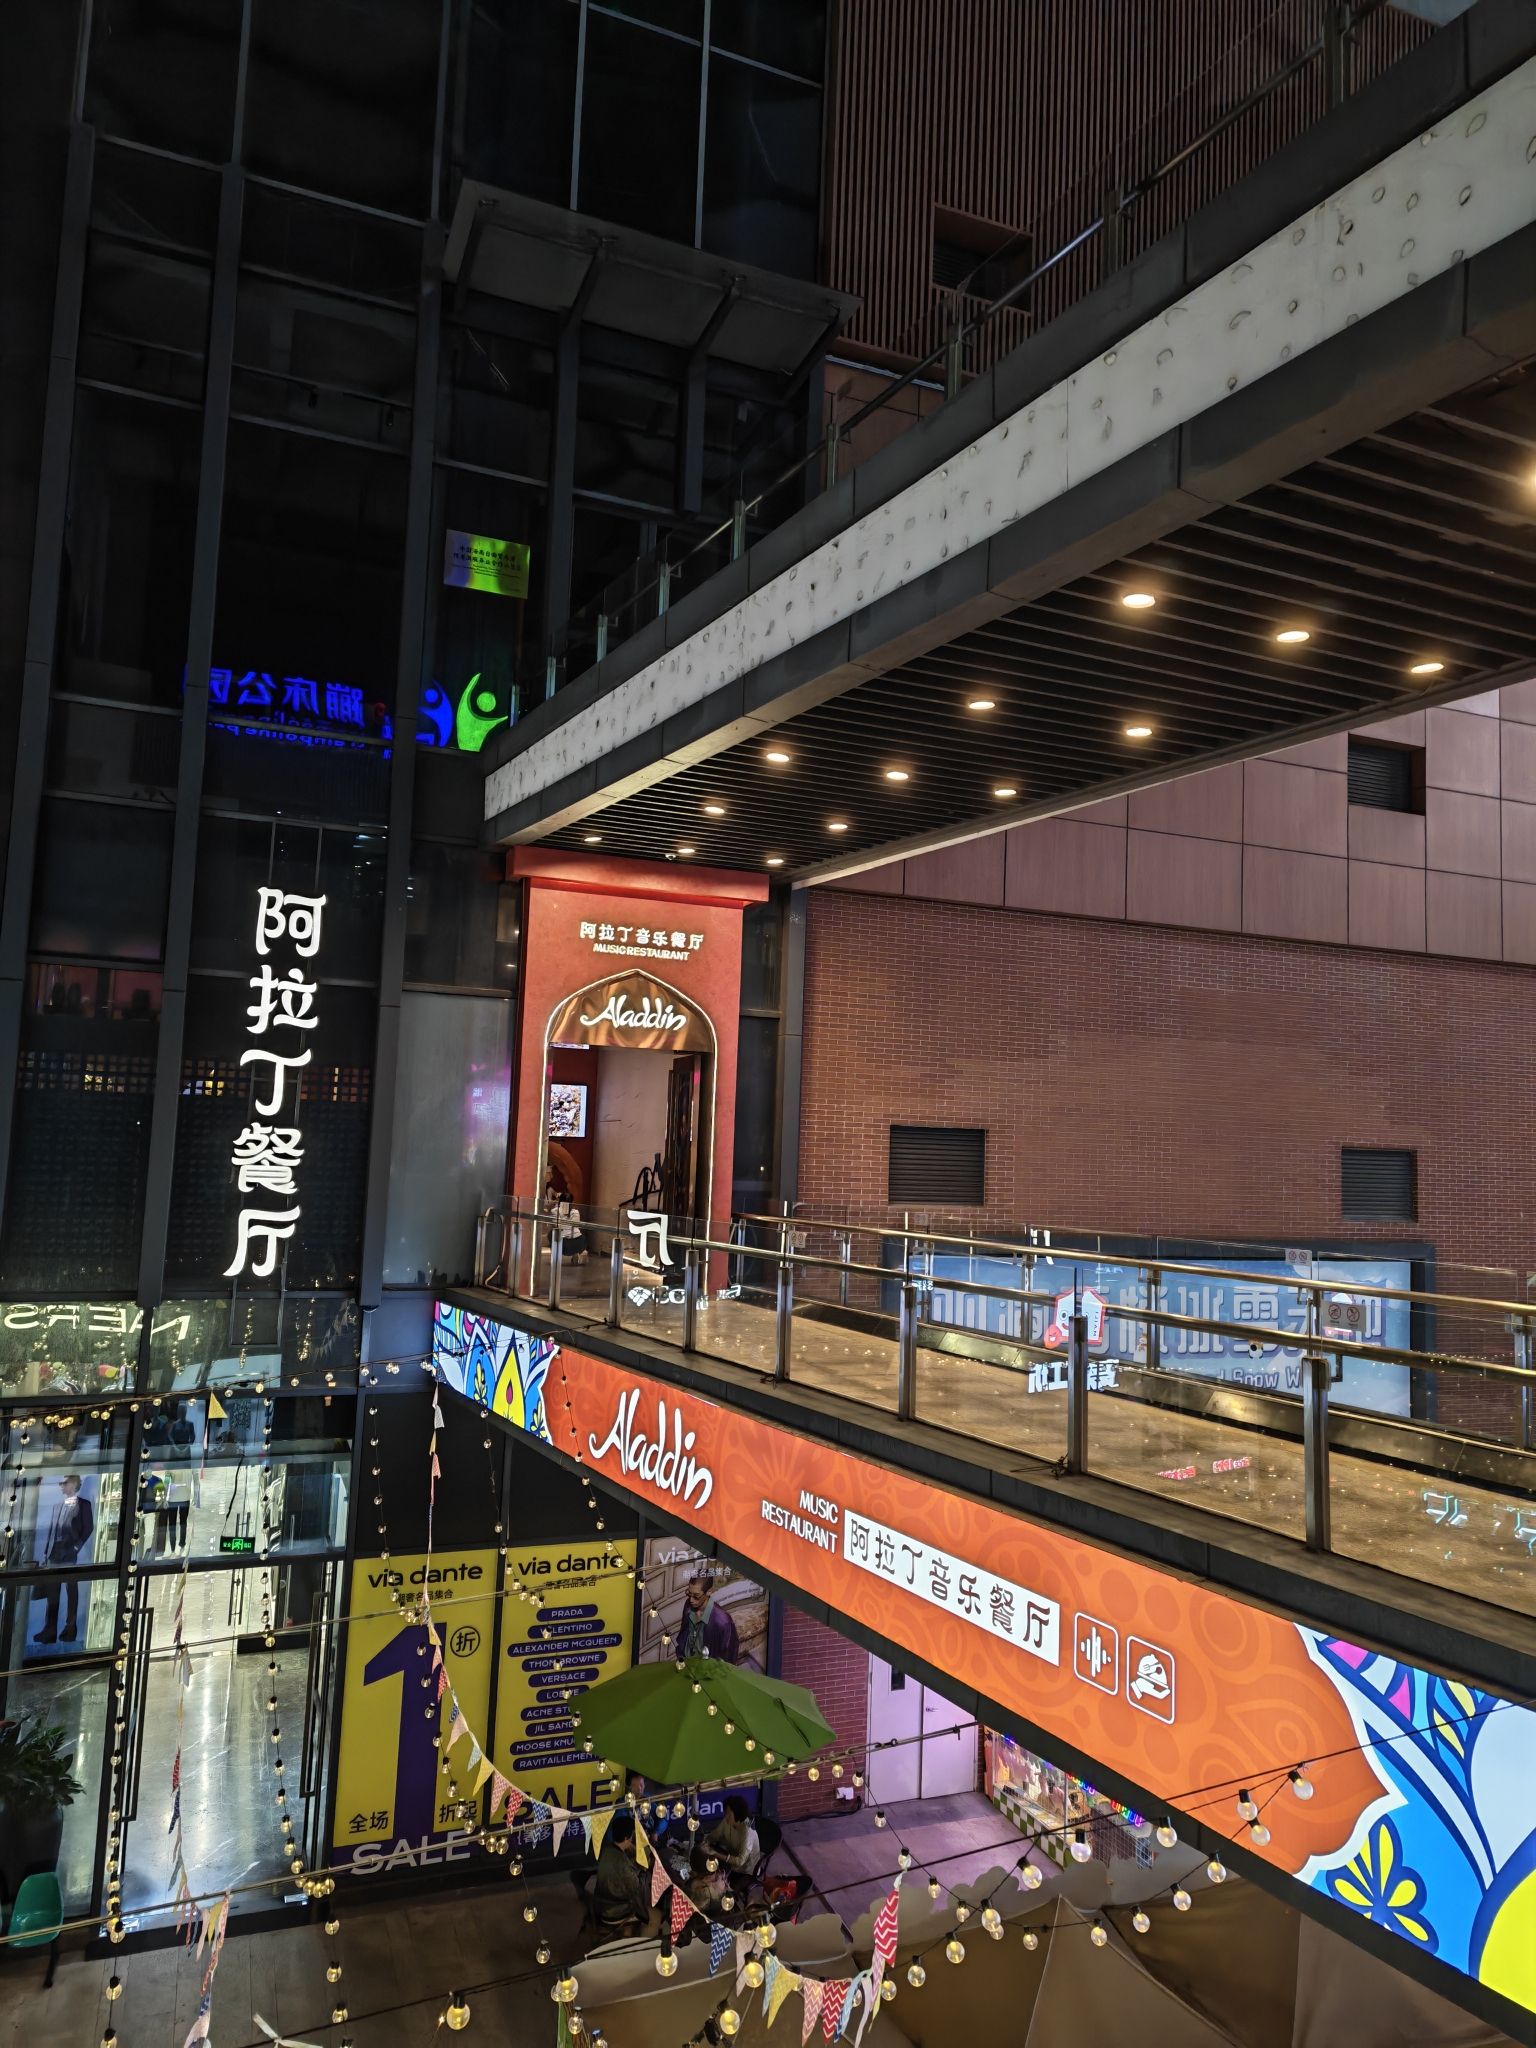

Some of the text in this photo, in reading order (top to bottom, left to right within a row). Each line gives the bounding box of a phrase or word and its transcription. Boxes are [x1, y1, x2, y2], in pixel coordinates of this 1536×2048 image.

[580, 921, 704, 950] 阿拉丁音乐餐厅
[580, 994, 687, 1031] Aladdin
[222, 886, 326, 1278] 阿拉丁餐厅
[589, 1388, 713, 1510] Aladdin
[799, 1489, 839, 1525] MUSIC
[761, 1499, 838, 1554] RESTAURANT
[518, 1552, 621, 1576] via dante
[658, 1547, 689, 1565] via
[368, 1563, 483, 1588] via dante
[850, 1517, 1051, 1650] 阿拉丁音乐餐厅
[551, 1608, 583, 1618] PRADA
[540, 1623, 593, 1634] VLENTINO
[512, 1636, 617, 1654] ALEXANDER MCQUEEN
[541, 1671, 586, 1683] VERSACE
[526, 1707, 553, 1718] ACNE
[363, 1622, 476, 1838] 1 折
[534, 1724, 545, 1734] JIL
[516, 1740, 552, 1752] MOOSE
[348, 1810, 389, 1834] 全场
[351, 1831, 471, 1876] SALE
